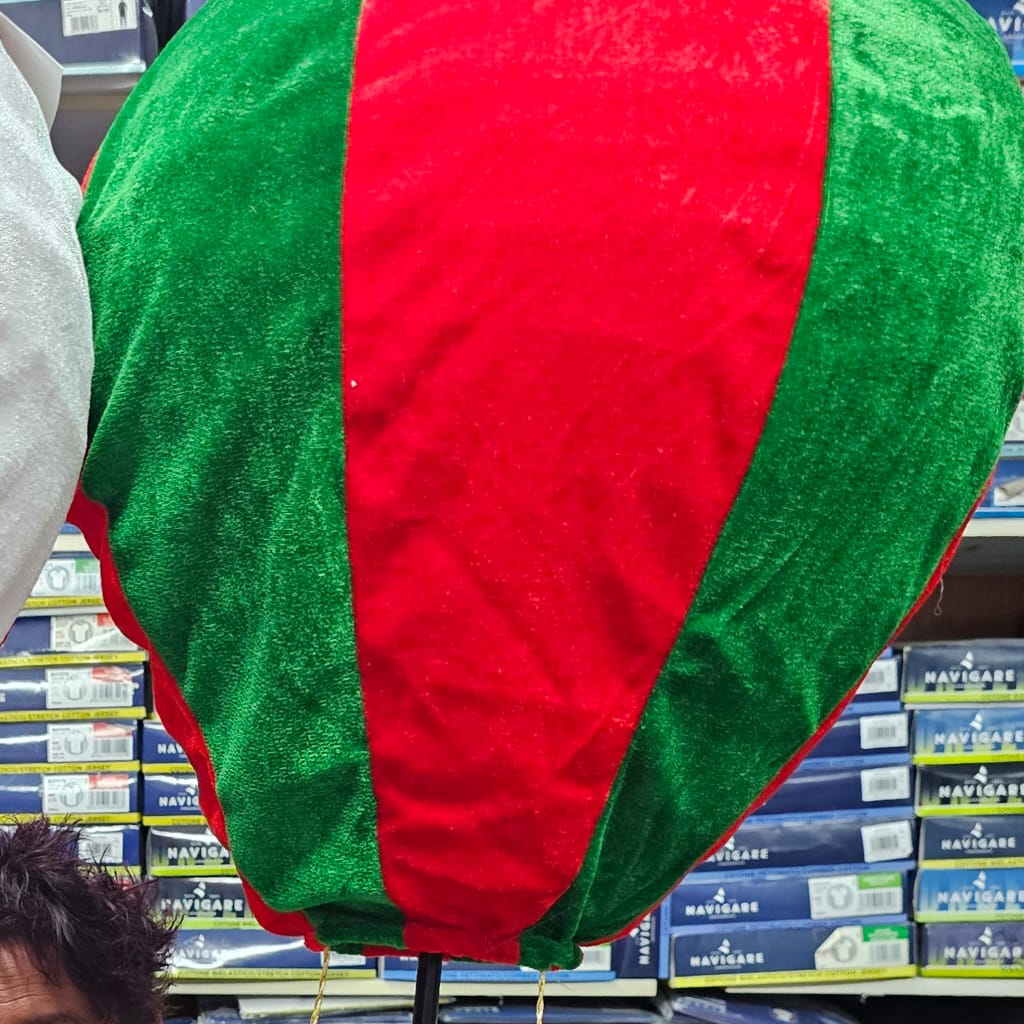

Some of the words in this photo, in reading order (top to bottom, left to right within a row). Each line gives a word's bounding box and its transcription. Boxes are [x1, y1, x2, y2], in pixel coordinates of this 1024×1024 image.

[925, 669, 1015, 684] NAVIGARE
[934, 730, 1024, 745] NAVIGARE
[159, 796, 199, 807] NAVIG
[941, 836, 1016, 850] NAVIGARE
[167, 846, 230, 859] NAVIGA
[685, 901, 759, 916] NAVIGARE
[638, 913, 651, 965] NAVIG
[690, 952, 765, 967] NAVIGARE
[944, 946, 1024, 959] NAVIGAR
